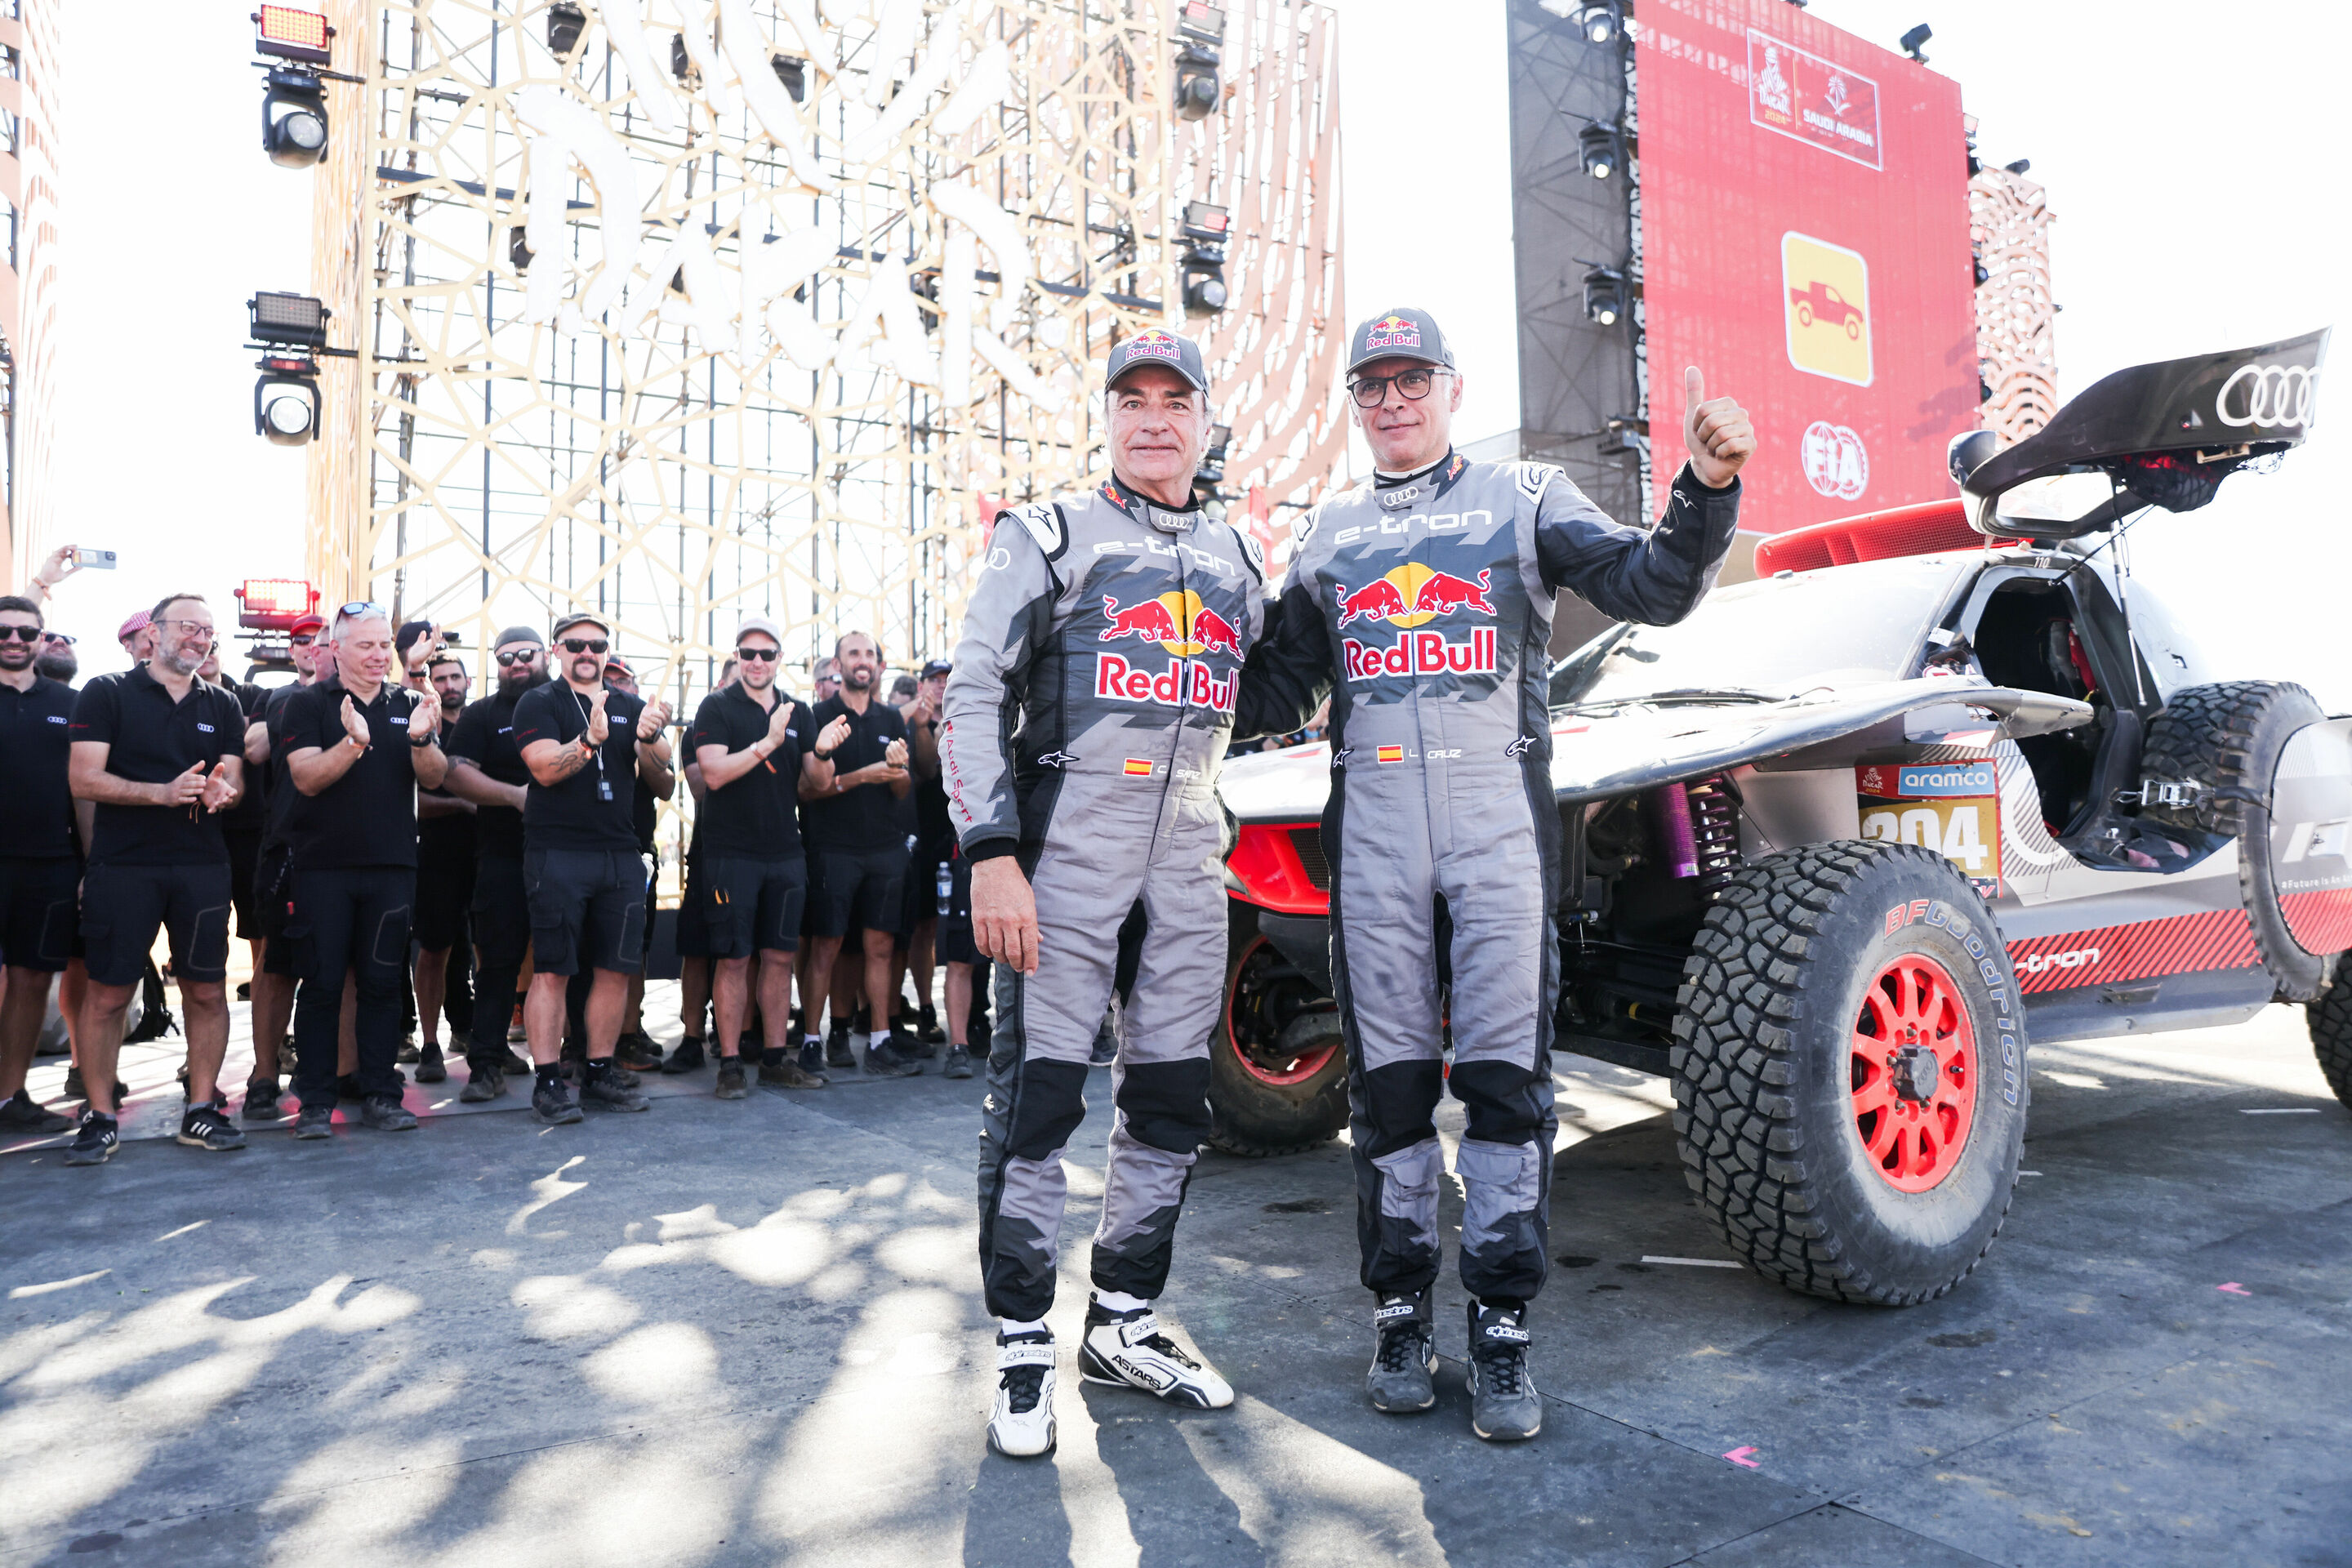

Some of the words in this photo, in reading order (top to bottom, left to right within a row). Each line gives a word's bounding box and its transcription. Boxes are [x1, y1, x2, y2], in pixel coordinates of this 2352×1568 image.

[1758, 83, 1792, 116] DAKAR
[1802, 108, 1837, 131] SAUDI
[1836, 121, 1875, 148] ARABIA
[1125, 344, 1152, 361] Red
[1153, 344, 1181, 360] Bull
[1366, 332, 1392, 351] Red
[1393, 332, 1421, 348] Bull
[1806, 434, 1861, 486] FIA
[1334, 510, 1493, 545] e-tron
[1093, 535, 1236, 577] e-tron
[2034, 555, 2051, 568] 110
[1341, 630, 1413, 683] Red
[1414, 626, 1498, 675] Bull
[1094, 652, 1184, 707] Red
[1187, 660, 1239, 714] Bull
[946, 739, 960, 776] Audi
[1427, 748, 1462, 760] CRUZ
[1862, 779, 1883, 790] DAKAR
[1904, 772, 1989, 786] aramco
[951, 779, 973, 823] Sport
[1862, 806, 1989, 871] 204
[2015, 947, 2100, 973] -tron
[1884, 899, 2018, 1107] BFGoodrich
[1111, 1354, 1160, 1390] ASTARS
